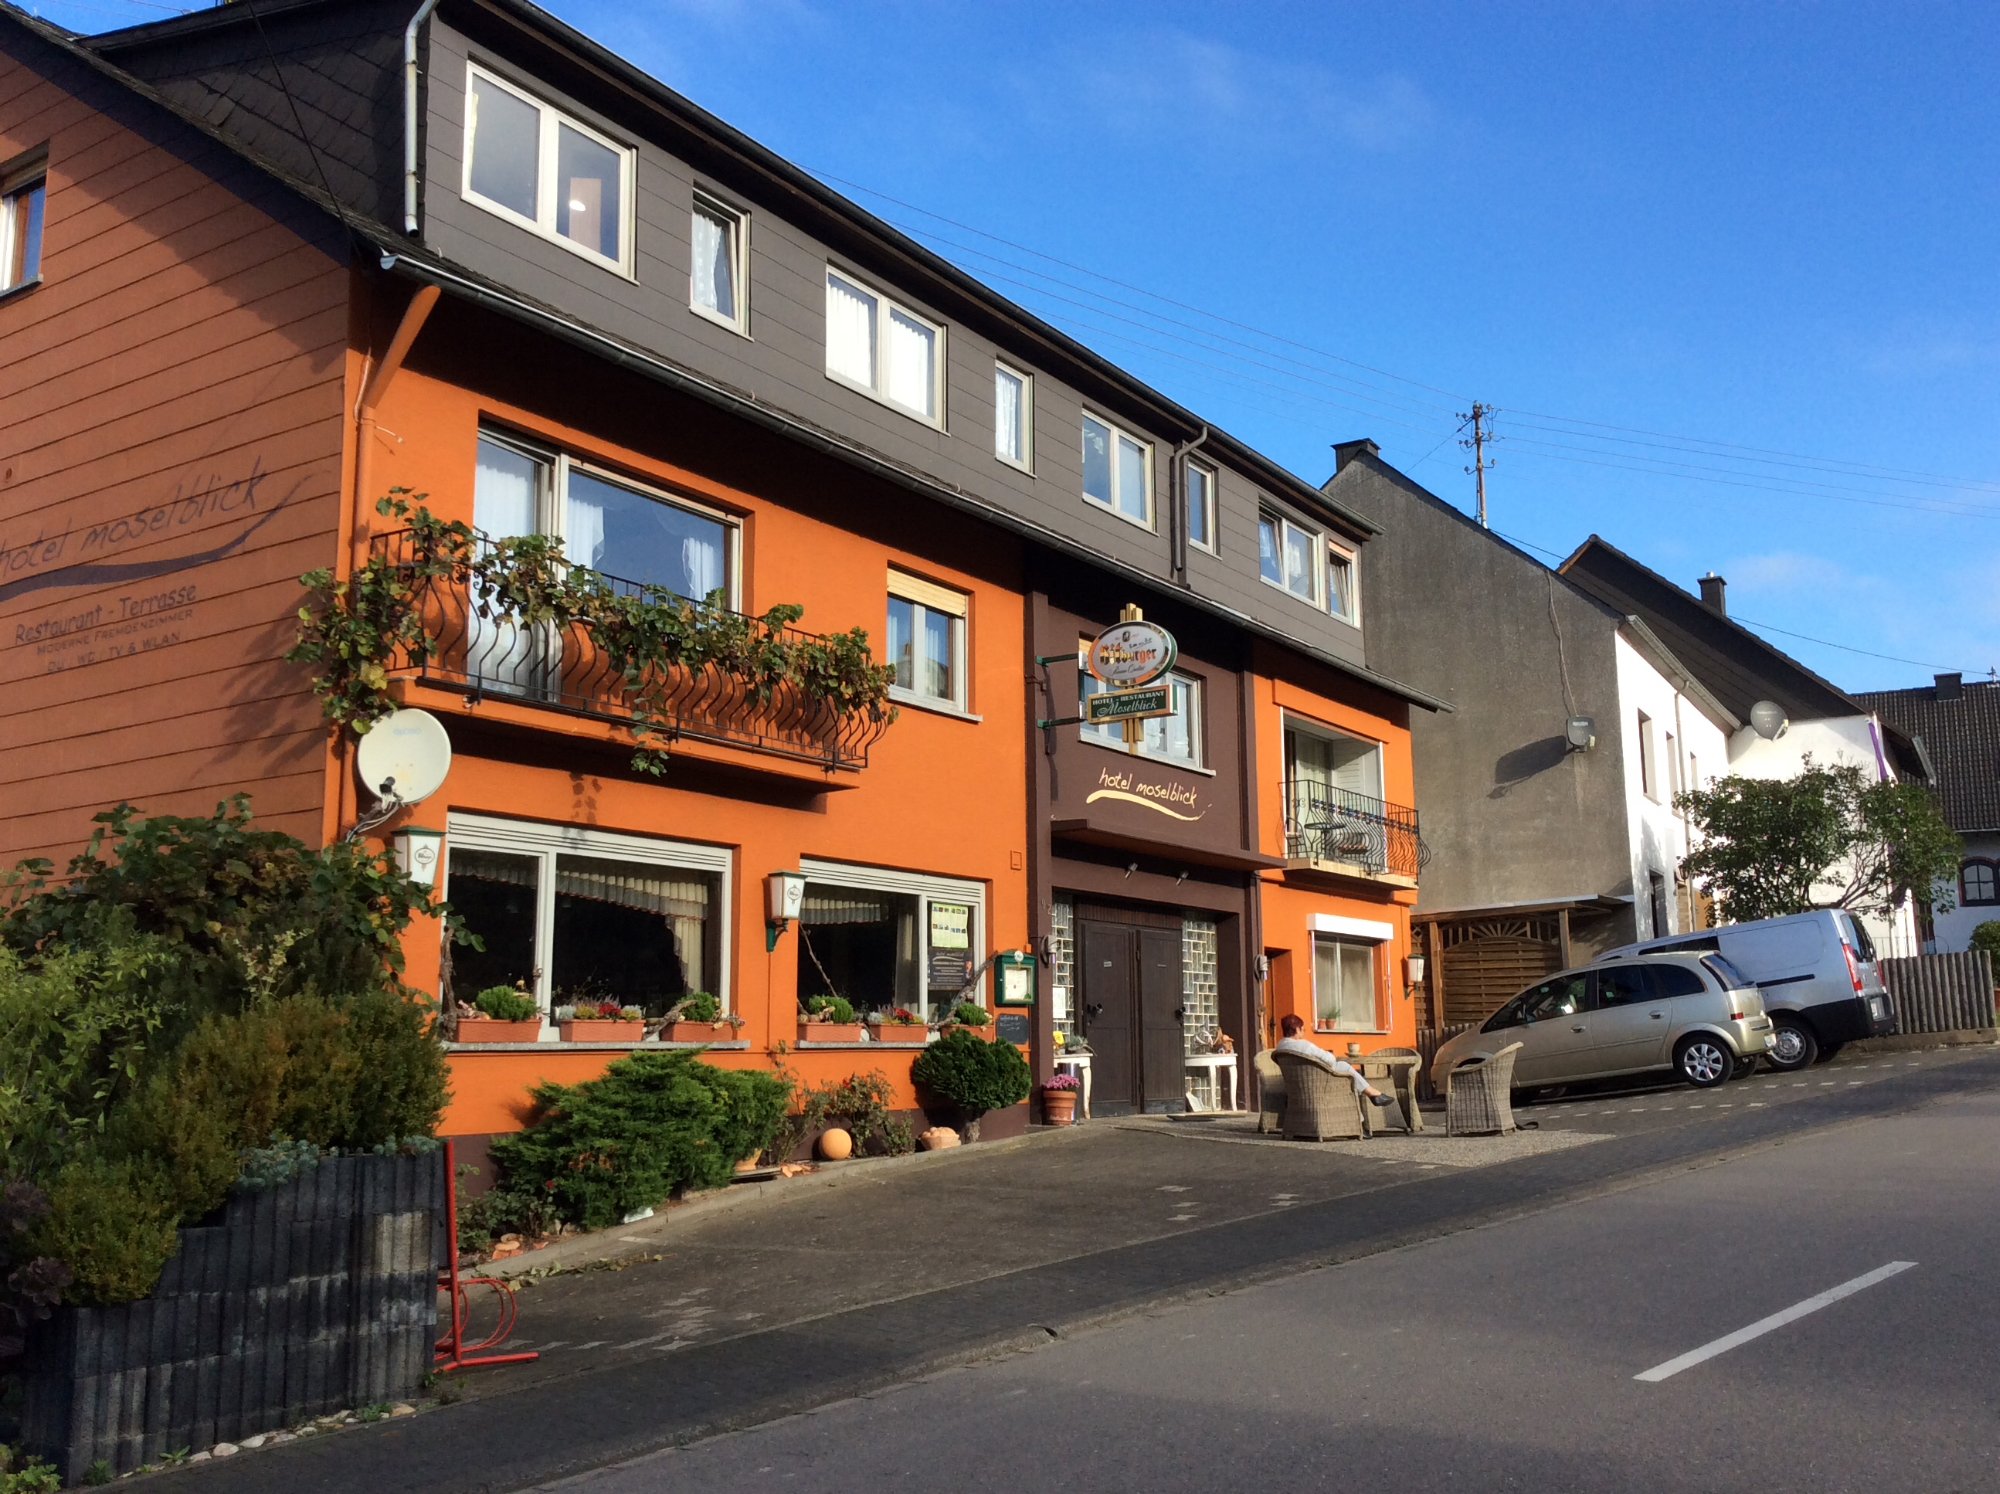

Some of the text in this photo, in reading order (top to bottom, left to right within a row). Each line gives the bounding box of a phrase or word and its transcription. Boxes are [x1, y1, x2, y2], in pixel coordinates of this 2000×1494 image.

[80, 455, 268, 552] moselblick
[15, 604, 104, 644] Restaurant
[119, 584, 198, 618] Terrasse
[36, 609, 194, 656] MODERNE FREMDENZIMMER
[142, 631, 181, 650] WLAN
[1092, 697, 1114, 706] HOTEL
[1120, 690, 1165, 703] RESTAURANT
[1096, 698, 1158, 717] Moselblick
[1098, 767, 1198, 809] hotel moselblick
